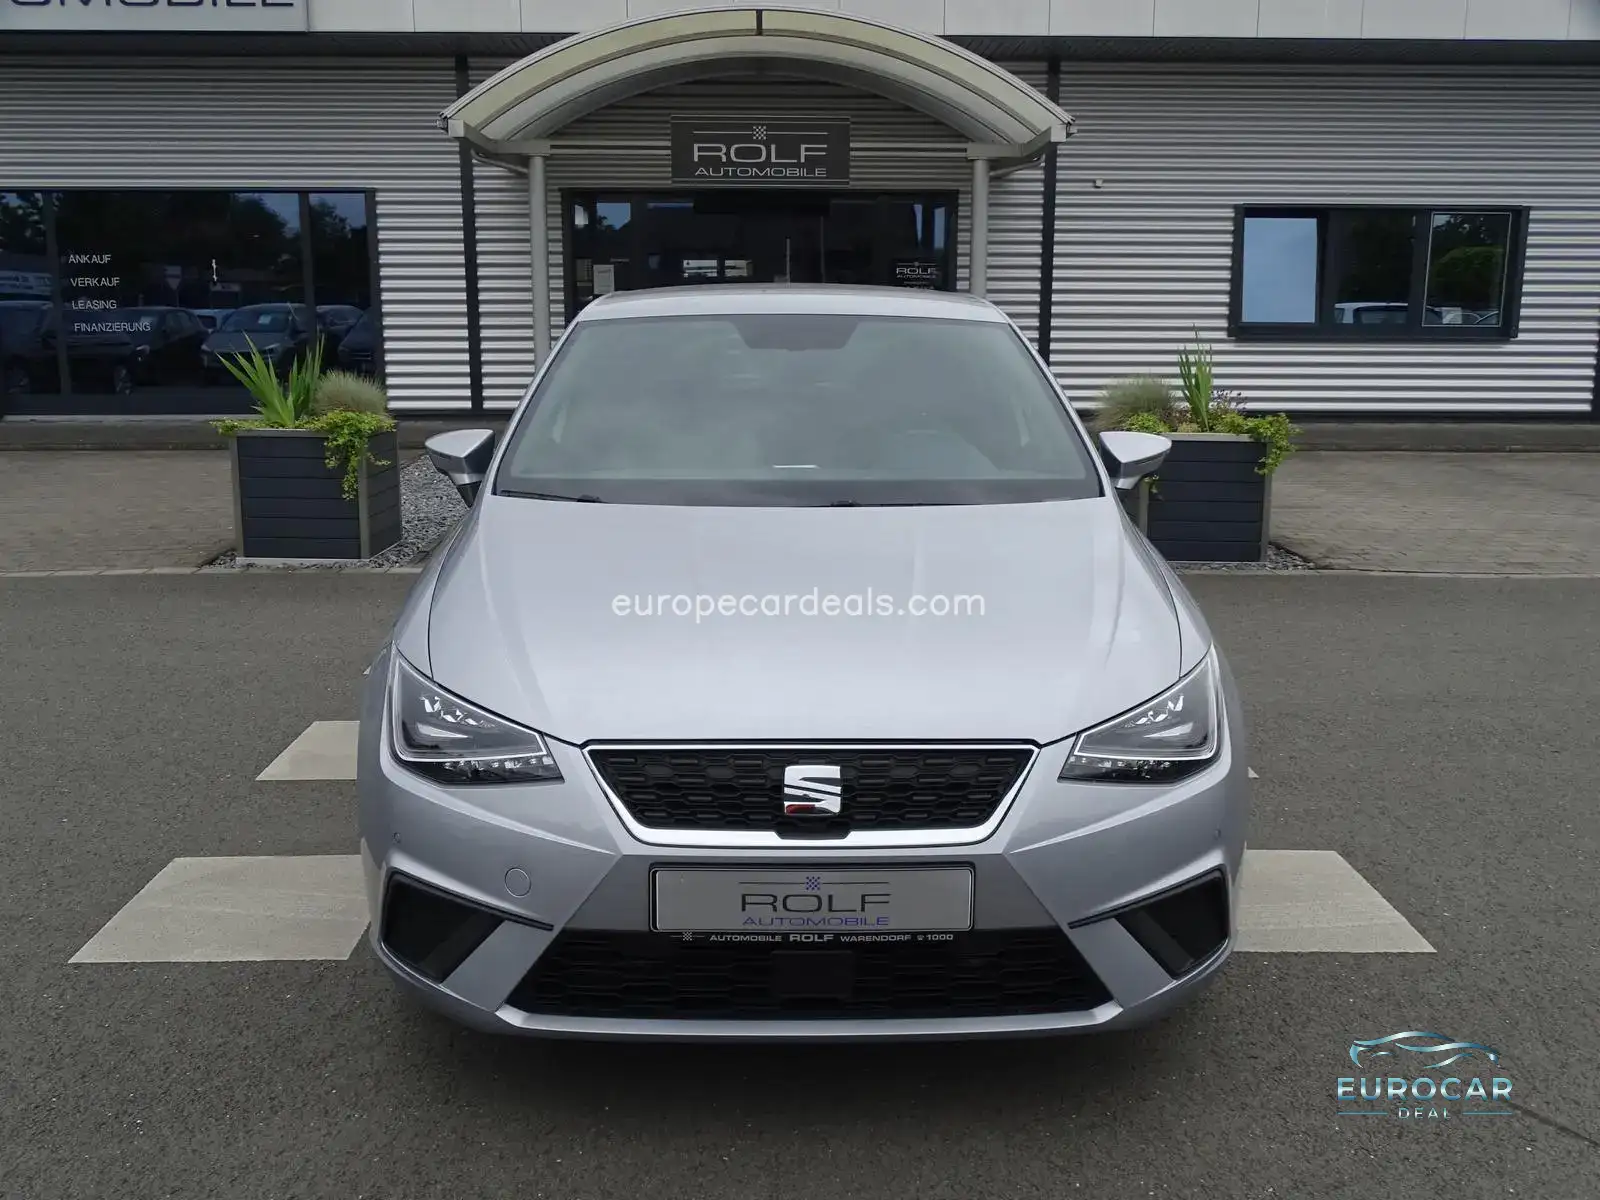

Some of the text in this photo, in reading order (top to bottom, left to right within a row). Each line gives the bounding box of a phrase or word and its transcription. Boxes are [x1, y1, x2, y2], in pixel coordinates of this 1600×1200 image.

[693, 143, 828, 163] ROLF
[694, 167, 827, 177] AUTOMOBILE
[68, 254, 112, 264] ANKAUF
[70, 277, 121, 287] VERKAUF
[72, 300, 117, 310] LEASING
[74, 322, 151, 332] FINANZIERUNG
[741, 894, 892, 913] ROLF
[742, 916, 890, 927] AUTOMOBILE
[709, 934, 954, 943] AUTOMOBILE ROLF WARENDORF 1000
